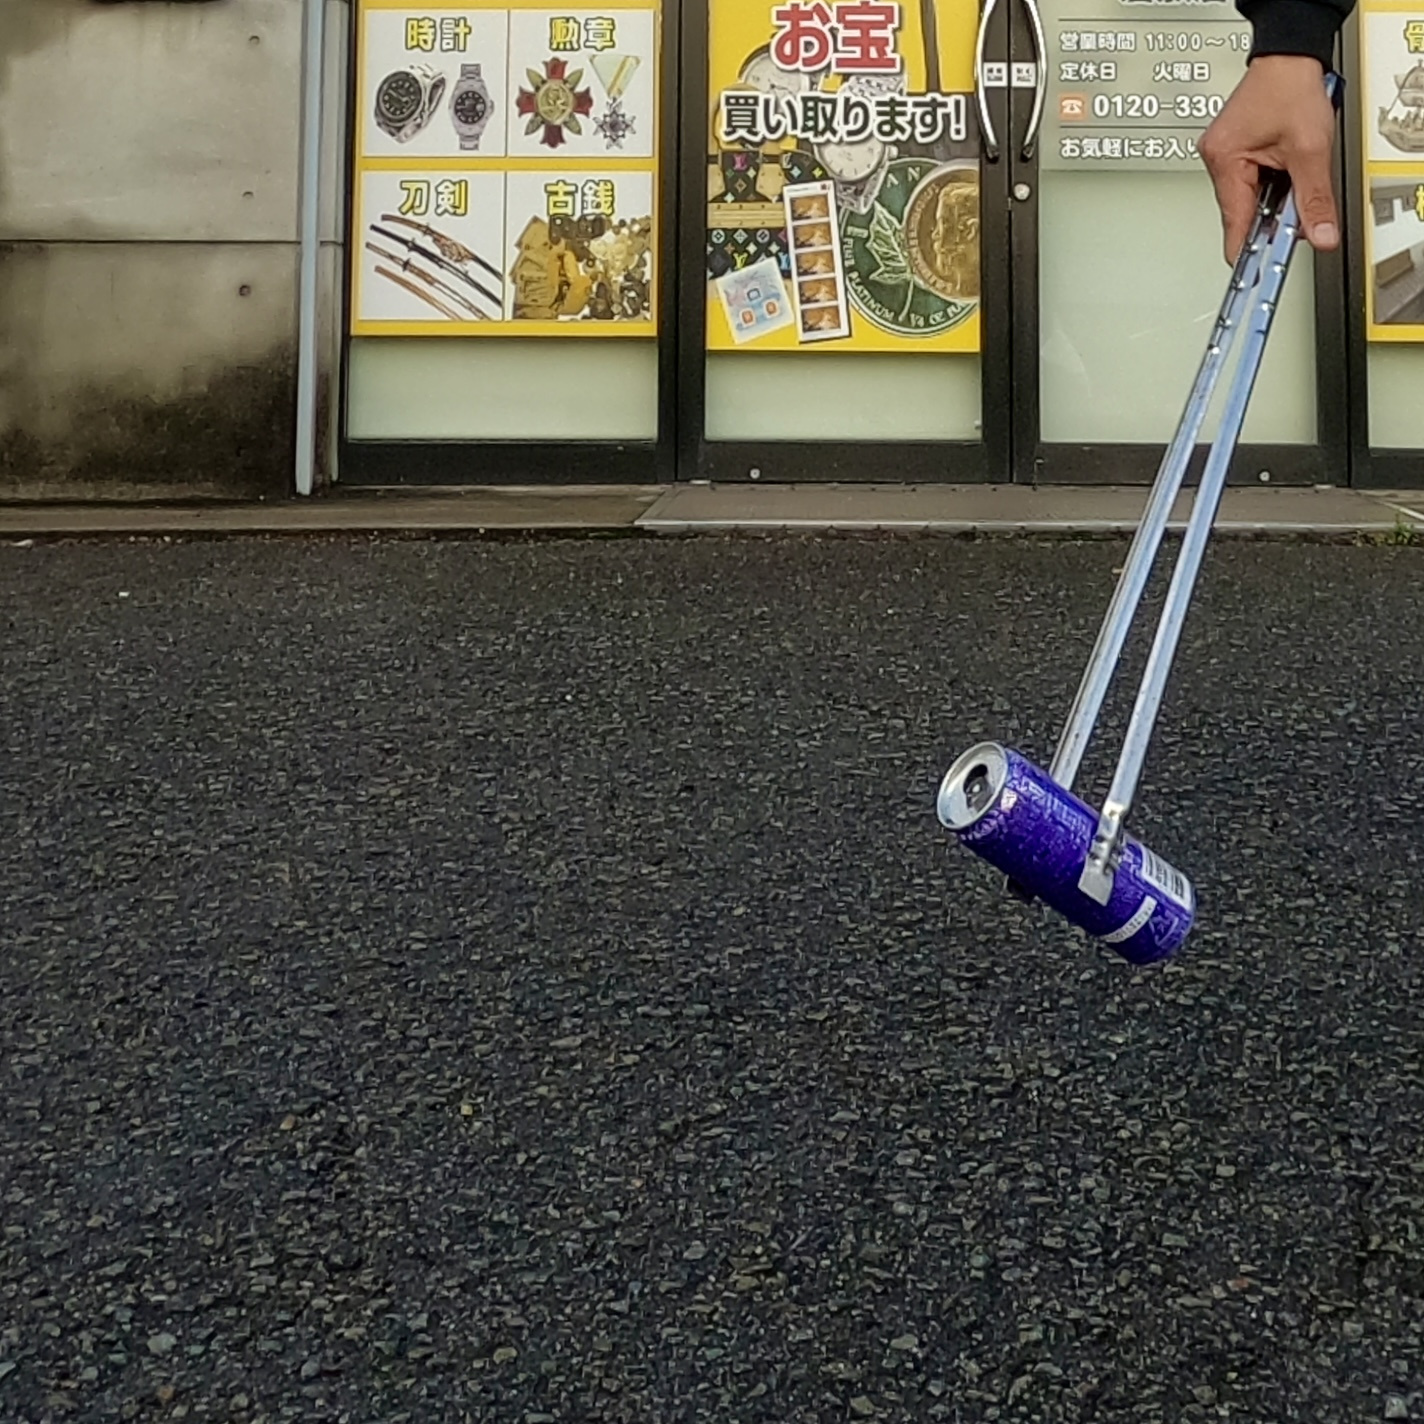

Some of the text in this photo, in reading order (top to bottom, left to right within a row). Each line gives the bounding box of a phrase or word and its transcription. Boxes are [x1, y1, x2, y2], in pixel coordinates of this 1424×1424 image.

[405, 17, 471, 52] 時計
[549, 17, 616, 52] 勲章
[771, 0, 901, 73] お宝
[1059, 32, 1136, 52] 営業時間
[1059, 61, 1210, 82] 定休日 火曜日
[721, 93, 967, 143] 買い取ります!
[399, 179, 468, 216] 刀剣
[545, 180, 616, 217] 古銭
